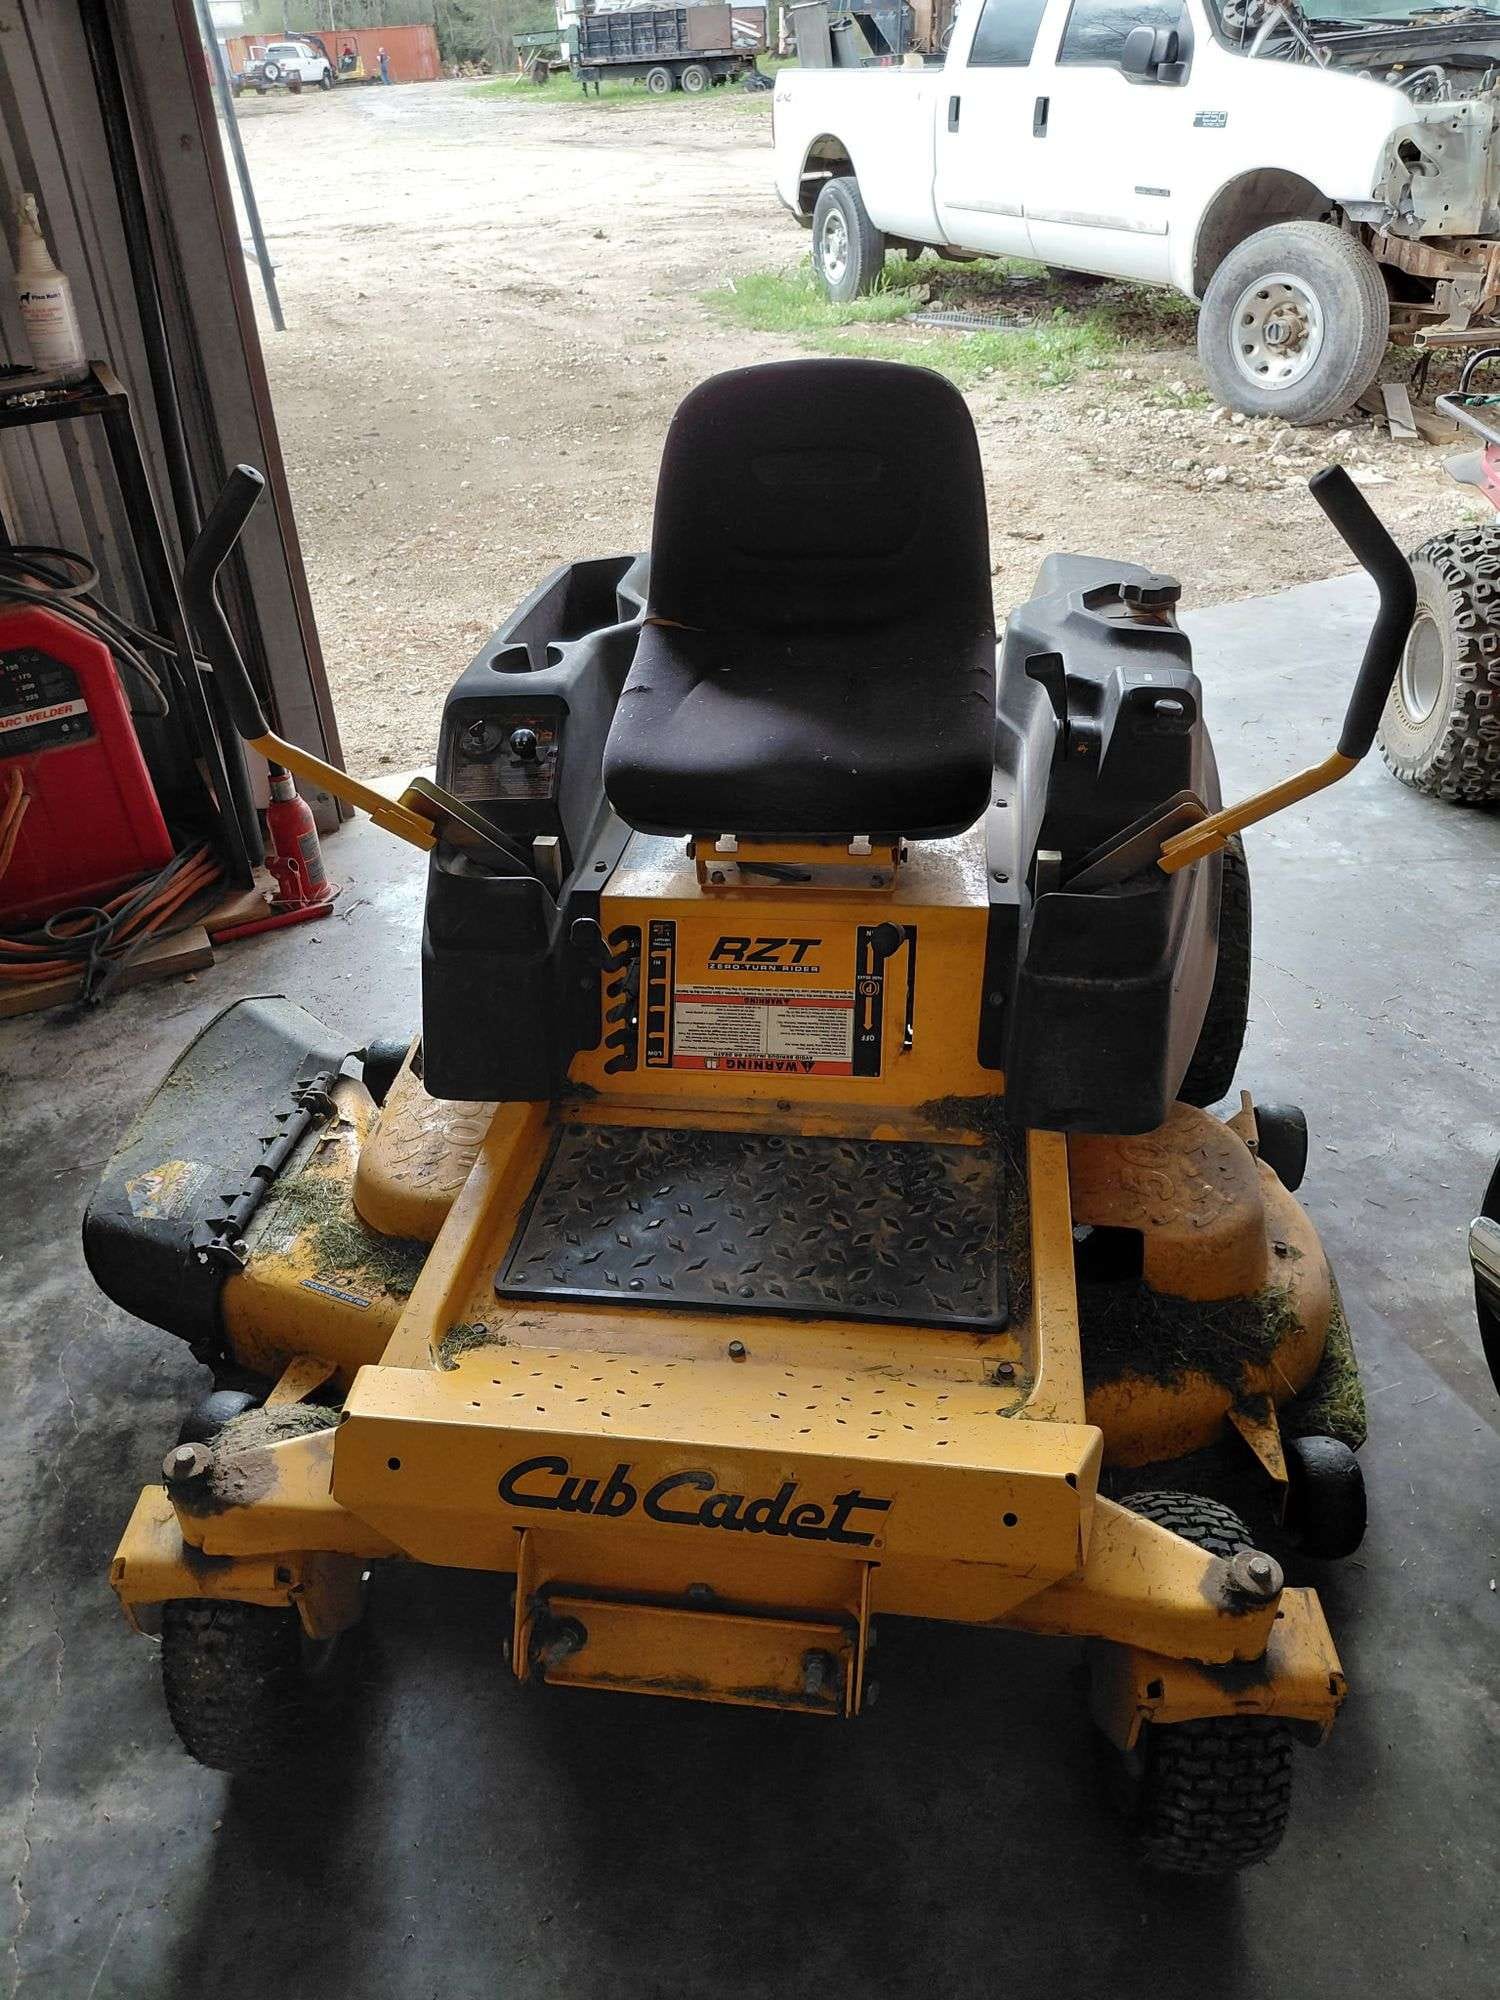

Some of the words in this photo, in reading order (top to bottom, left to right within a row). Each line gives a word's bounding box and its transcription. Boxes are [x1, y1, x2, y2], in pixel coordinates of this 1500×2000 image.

[0, 717, 22, 729] ARC
[25, 704, 73, 722] WELDER
[708, 935, 823, 963] RZT
[744, 997, 784, 1005] WARNING
[726, 1059, 798, 1072] WARNING
[498, 1455, 638, 1517] Cub
[642, 1470, 893, 1547] Cadet
